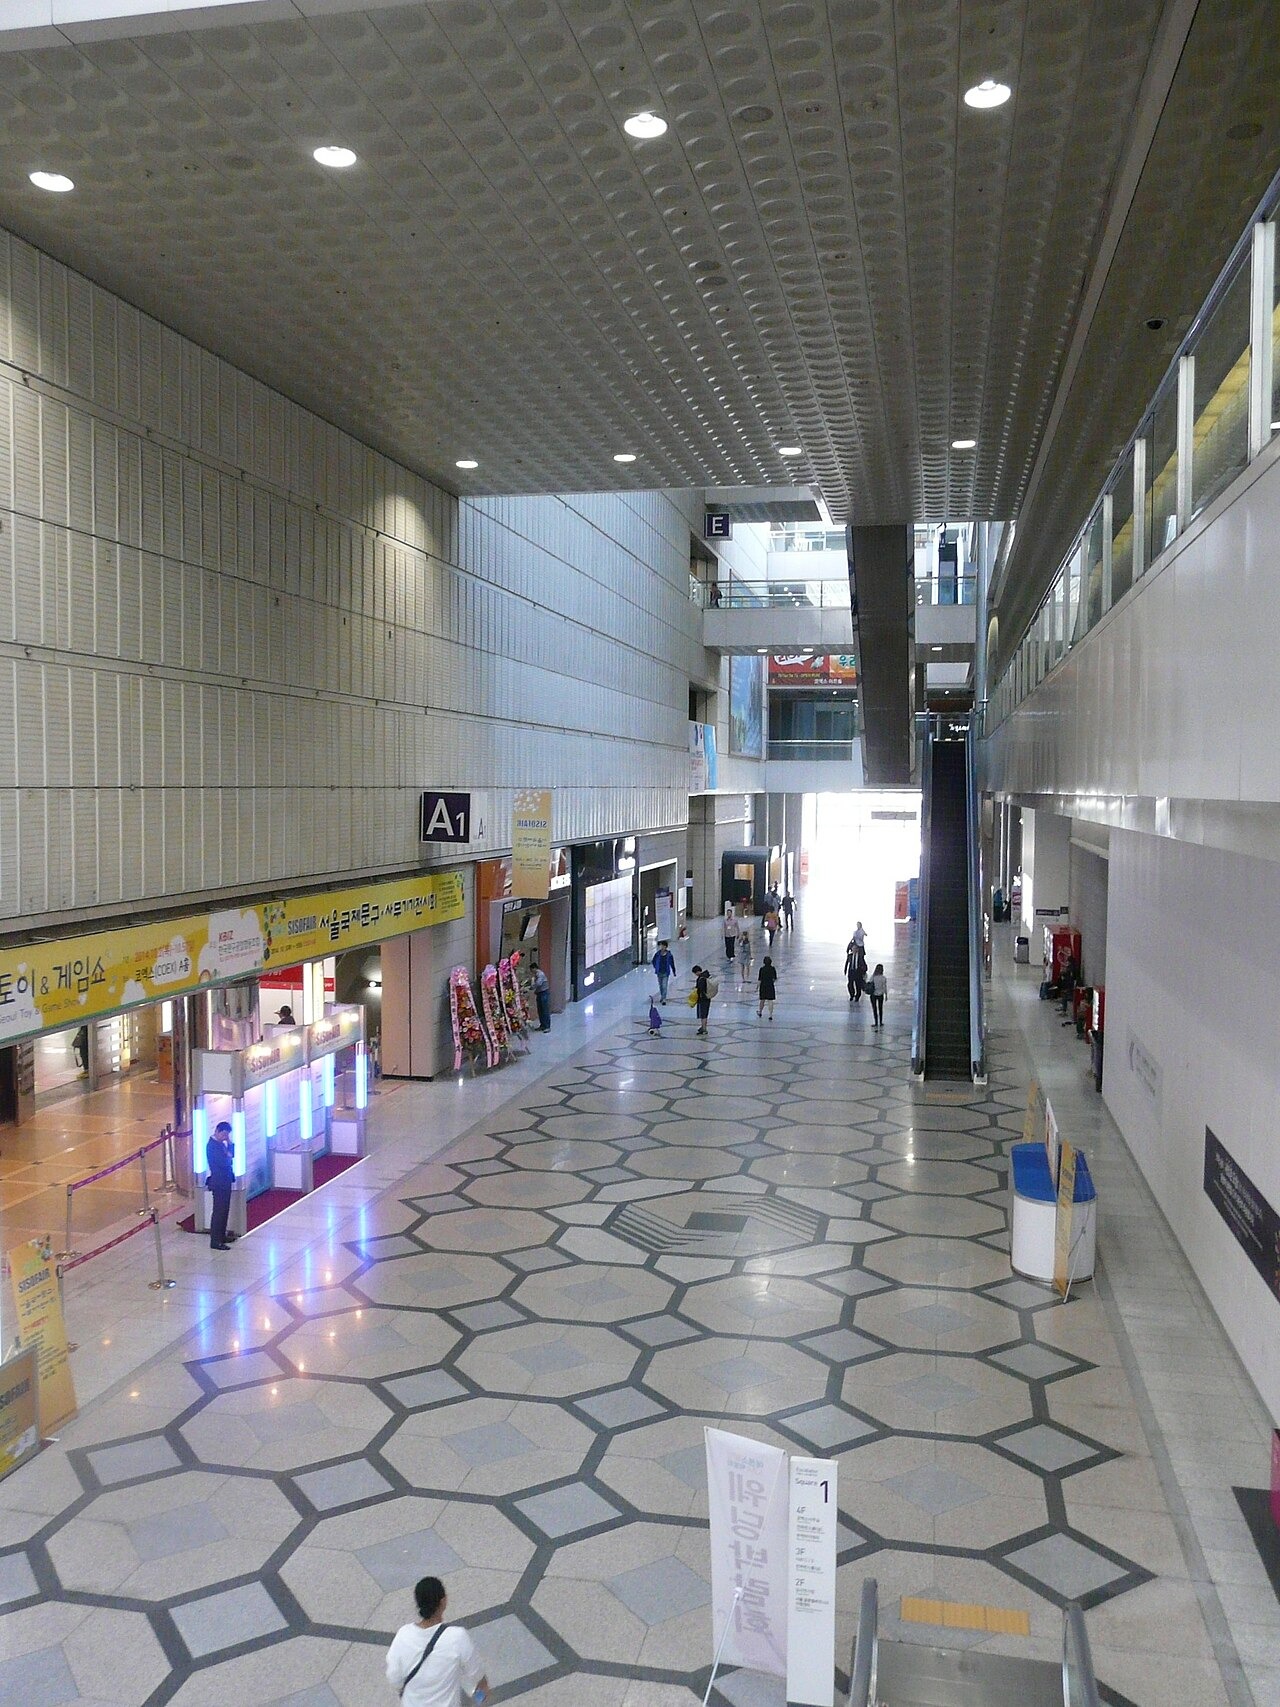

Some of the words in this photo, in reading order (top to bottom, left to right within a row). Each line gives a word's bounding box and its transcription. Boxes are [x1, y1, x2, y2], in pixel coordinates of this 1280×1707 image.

[712, 516, 724, 534] E
[426, 798, 465, 837] A1
[40, 976, 49, 995] &
[52, 955, 106, 993] 게임쇼
[820, 1480, 829, 1503] 1
